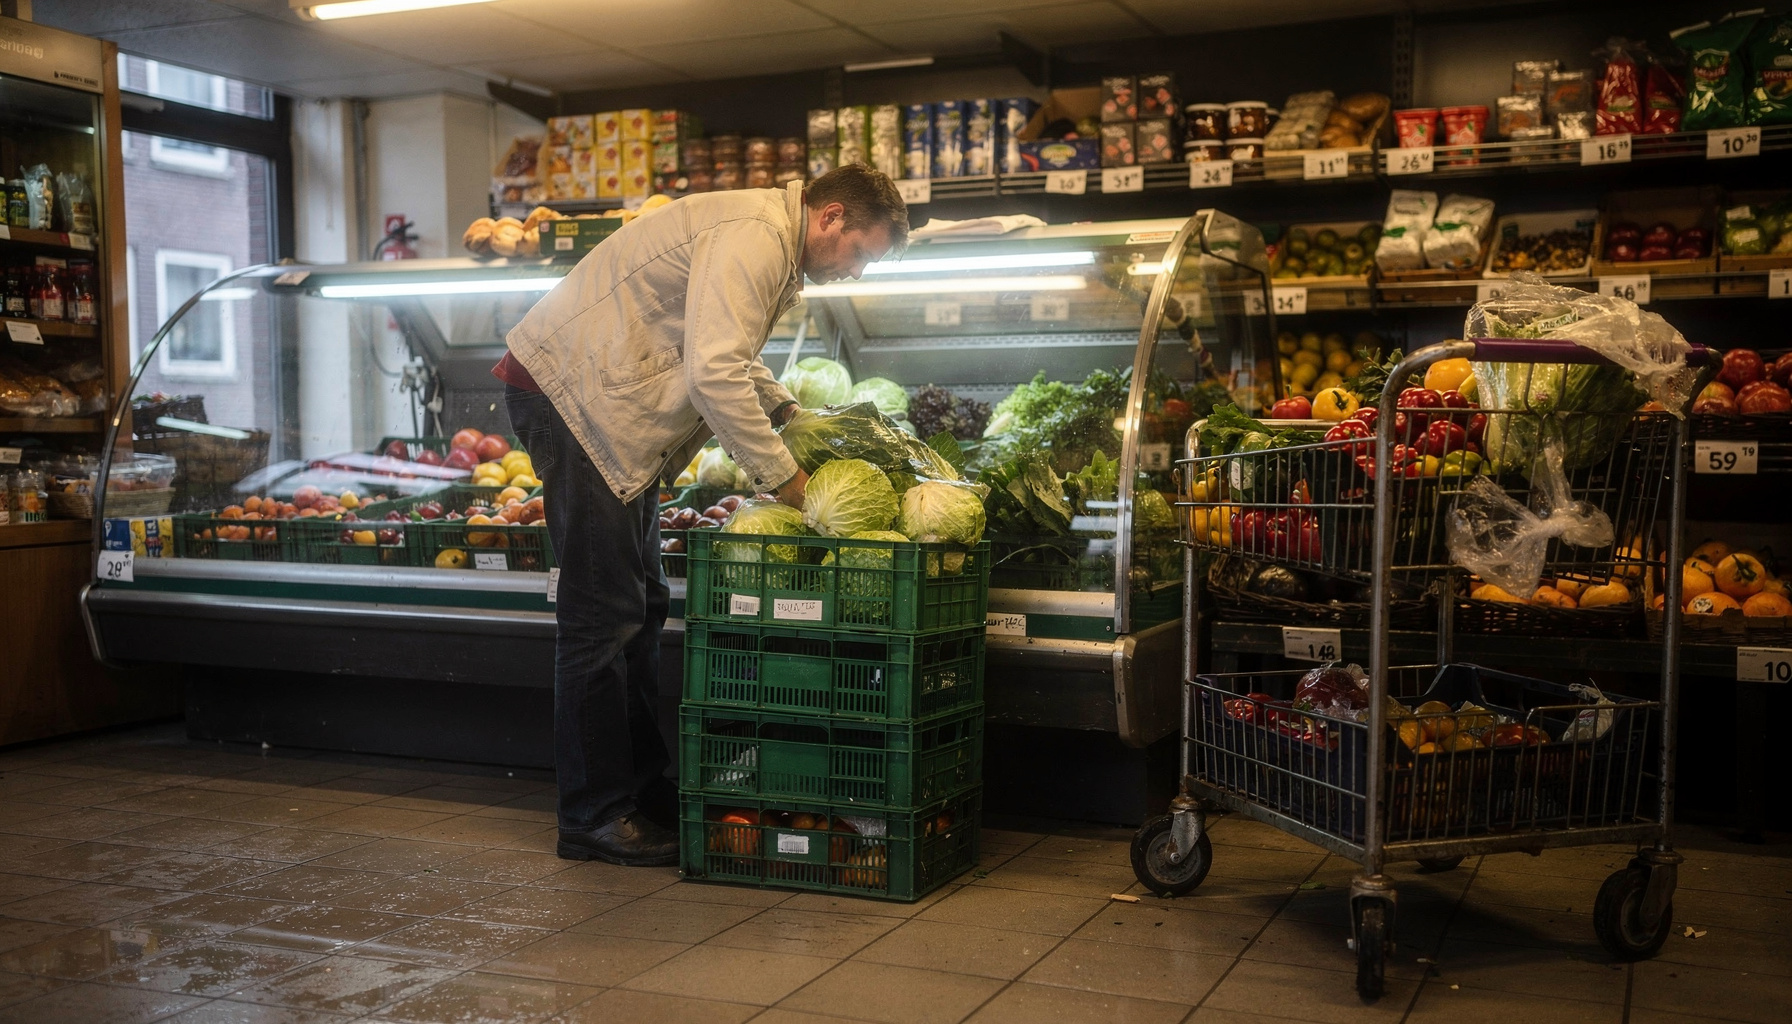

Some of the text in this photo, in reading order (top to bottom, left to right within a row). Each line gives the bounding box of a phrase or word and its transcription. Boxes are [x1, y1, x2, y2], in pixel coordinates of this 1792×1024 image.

[1723, 138, 1744, 154] 10
[1709, 451, 1737, 471] 59
[1764, 661, 1792, 682] 10
